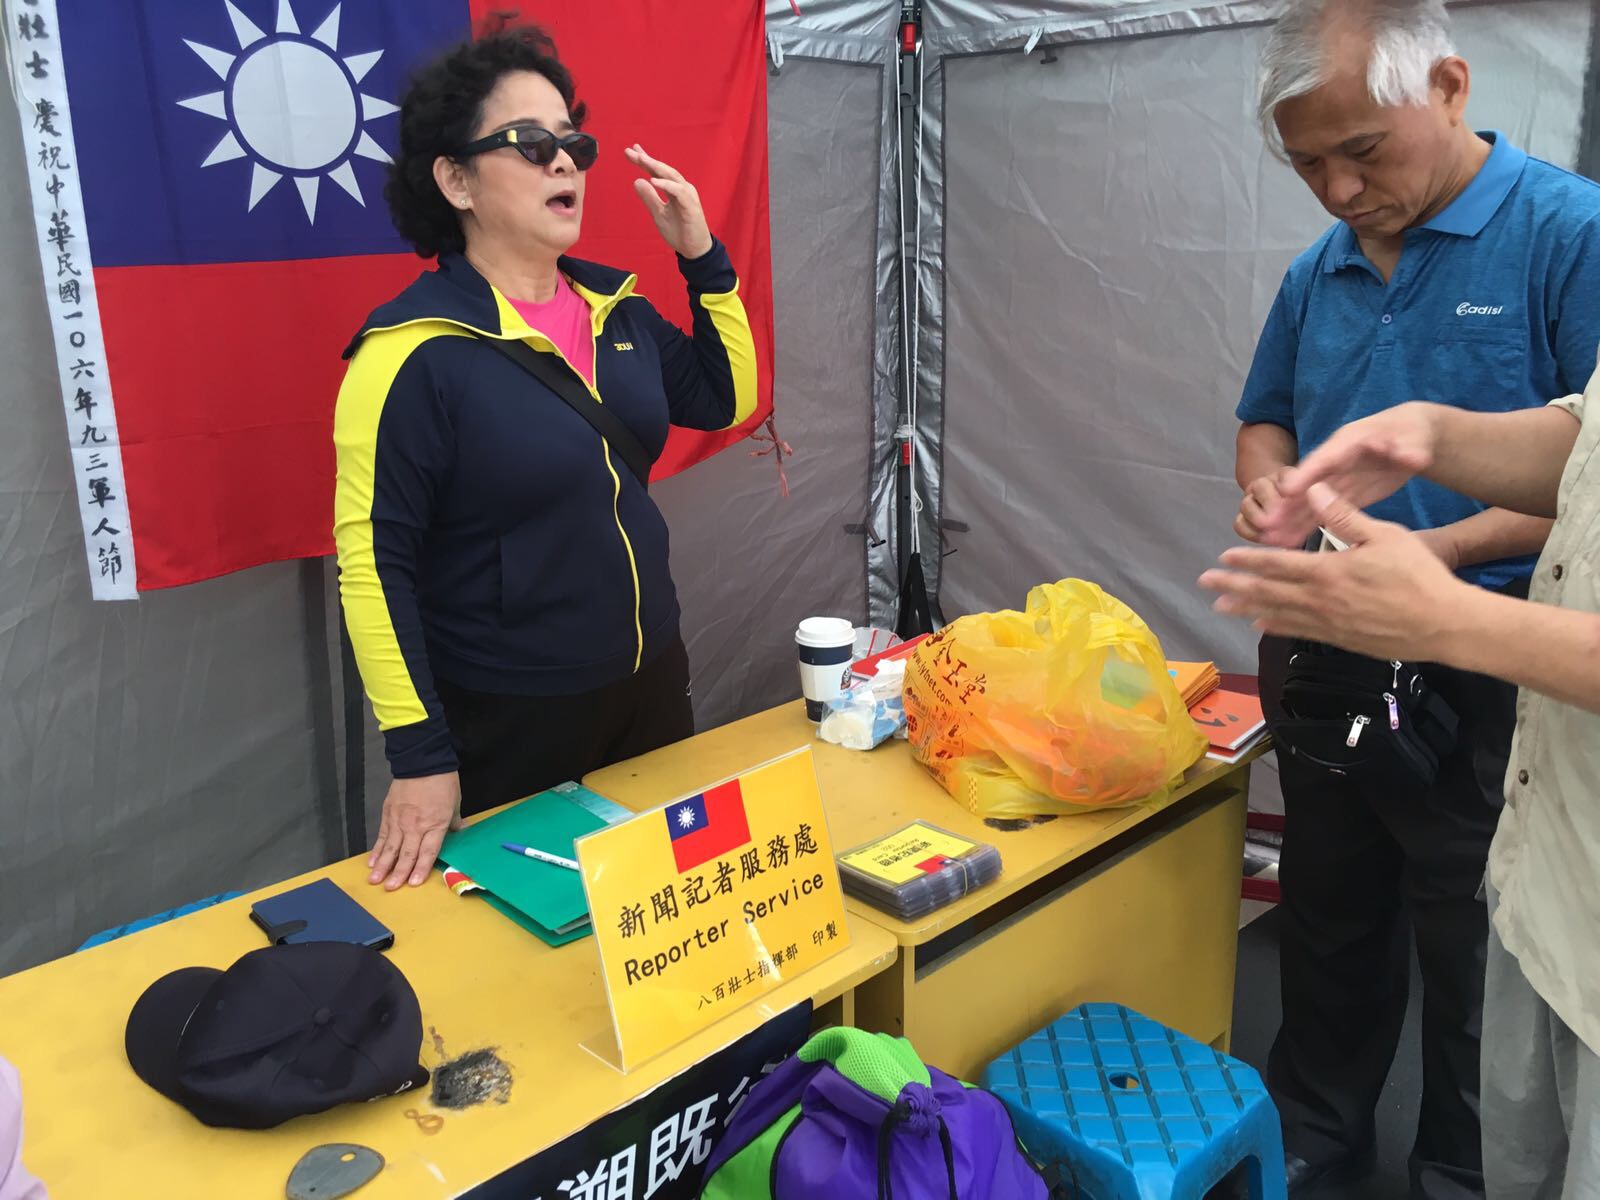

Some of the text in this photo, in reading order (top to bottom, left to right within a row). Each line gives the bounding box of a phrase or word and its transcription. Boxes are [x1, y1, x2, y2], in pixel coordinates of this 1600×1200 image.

[617, 823, 819, 939] 新聞記者服務處
[624, 872, 824, 985] Reporter Service
[697, 921, 838, 1010] 八百壯士指揮部 印製
